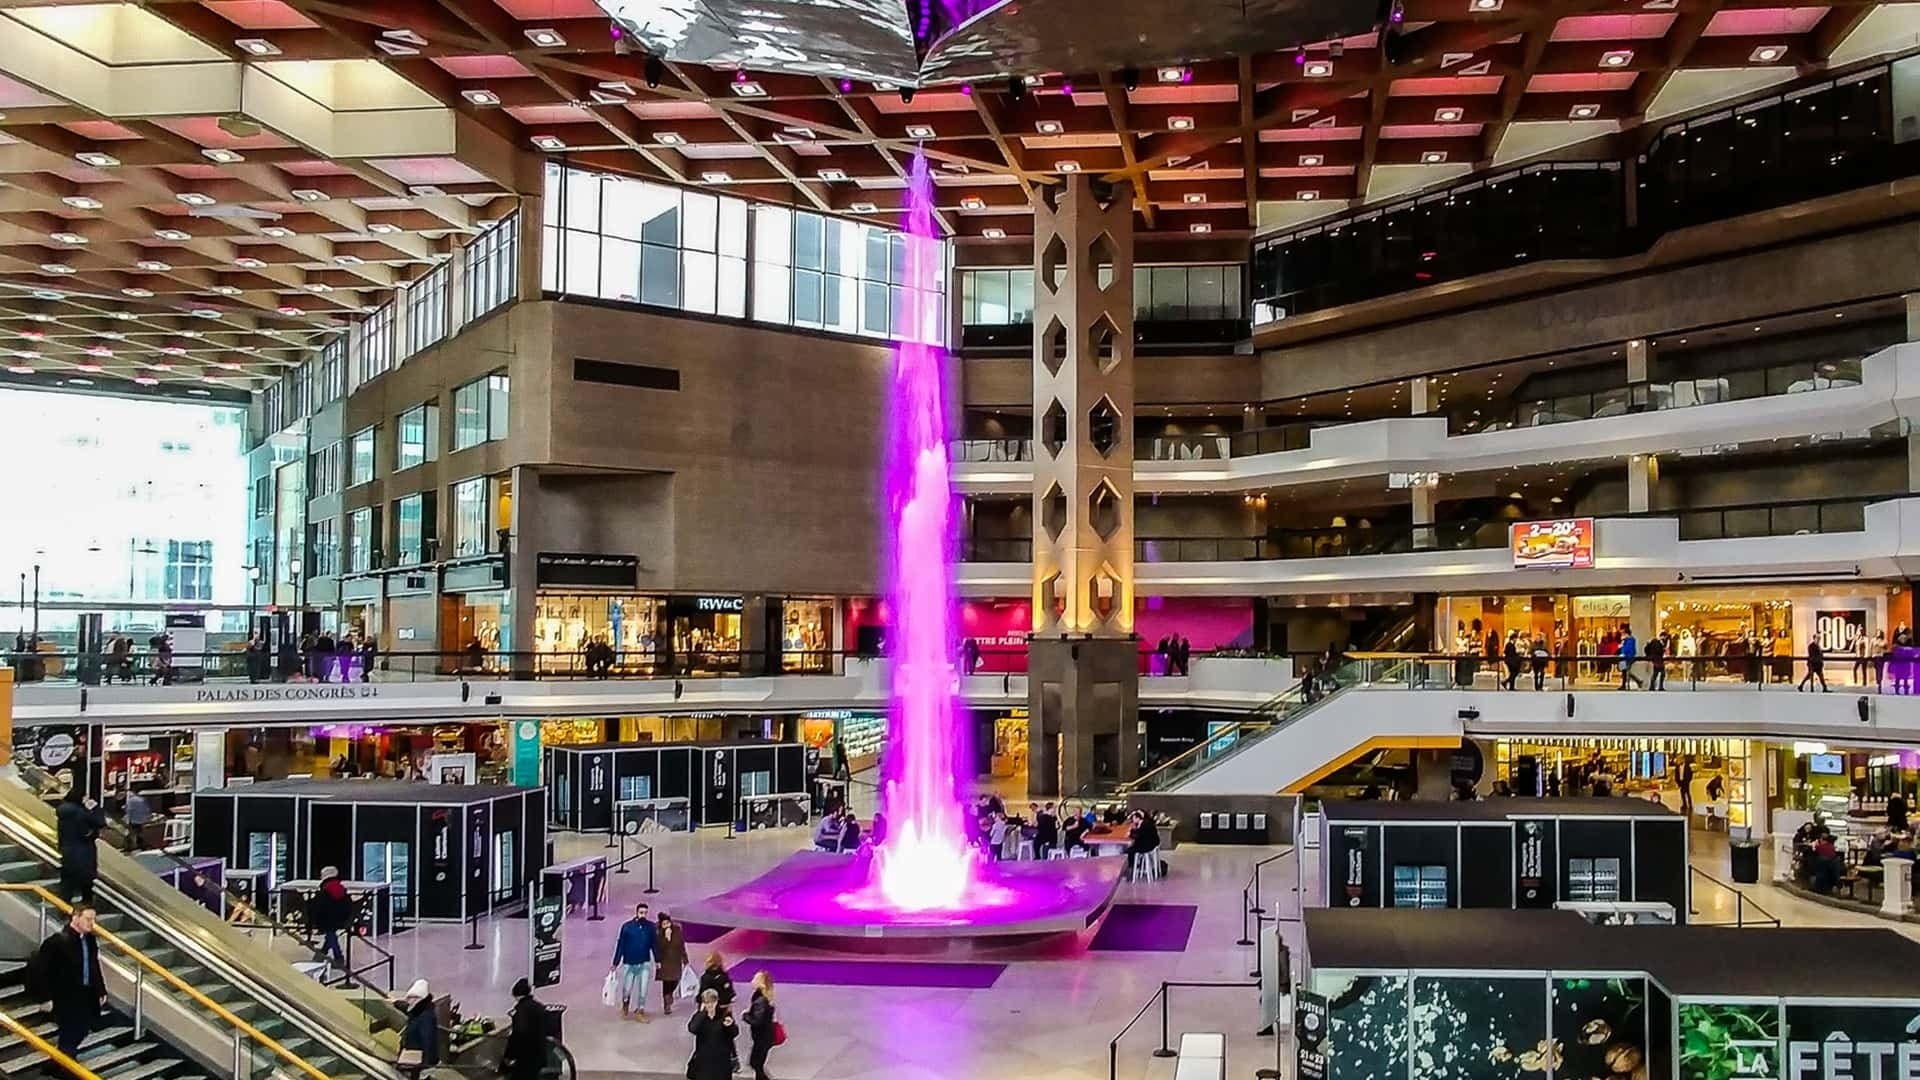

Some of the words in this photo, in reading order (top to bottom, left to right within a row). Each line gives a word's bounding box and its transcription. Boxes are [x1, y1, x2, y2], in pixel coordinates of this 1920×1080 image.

[698, 597, 743, 610] RW&C
[196, 688, 250, 701] PALAIS
[254, 688, 281, 700] DES
[285, 686, 356, 700] CONGRÈS
[1736, 1052, 1770, 1074] LA
[1789, 1031, 1920, 1080] FÊTE
